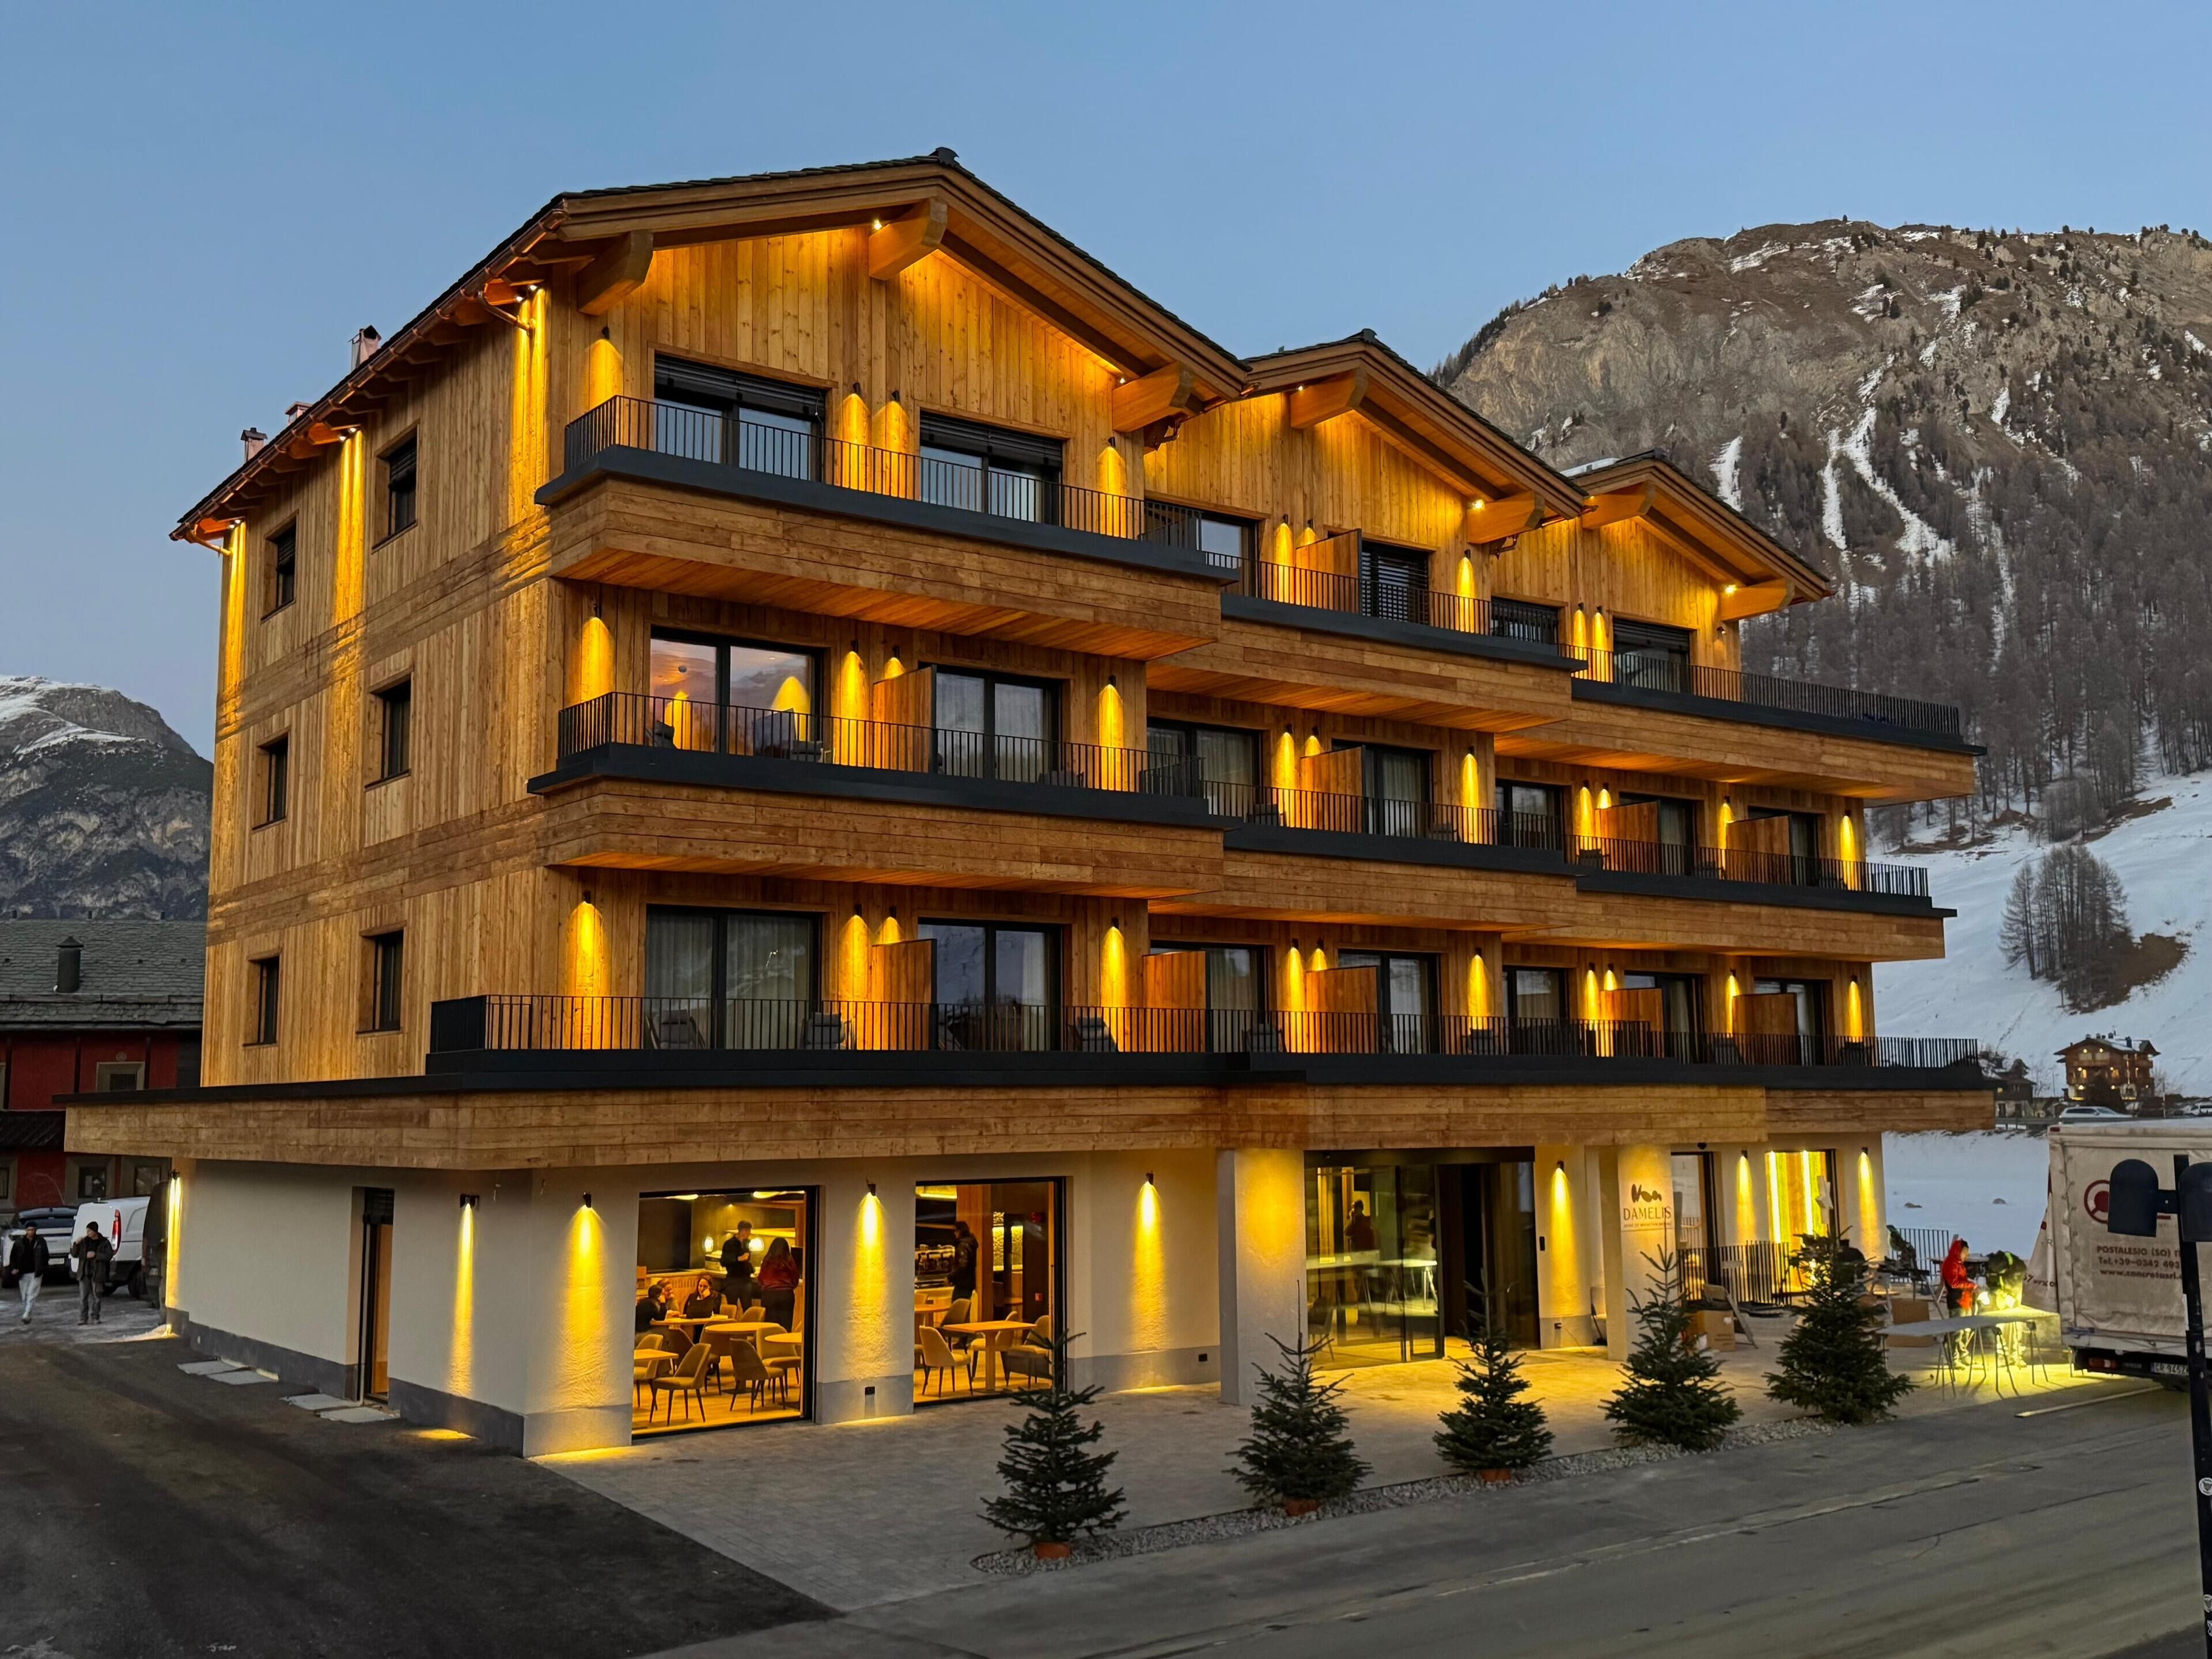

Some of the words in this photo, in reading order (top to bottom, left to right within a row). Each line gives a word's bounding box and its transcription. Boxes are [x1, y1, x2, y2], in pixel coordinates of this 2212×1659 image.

[1623, 1207, 1672, 1221] DAMELIS
[2097, 1245, 2147, 1256] POSTALESIO
[2152, 1248, 2171, 1257] (SO)
